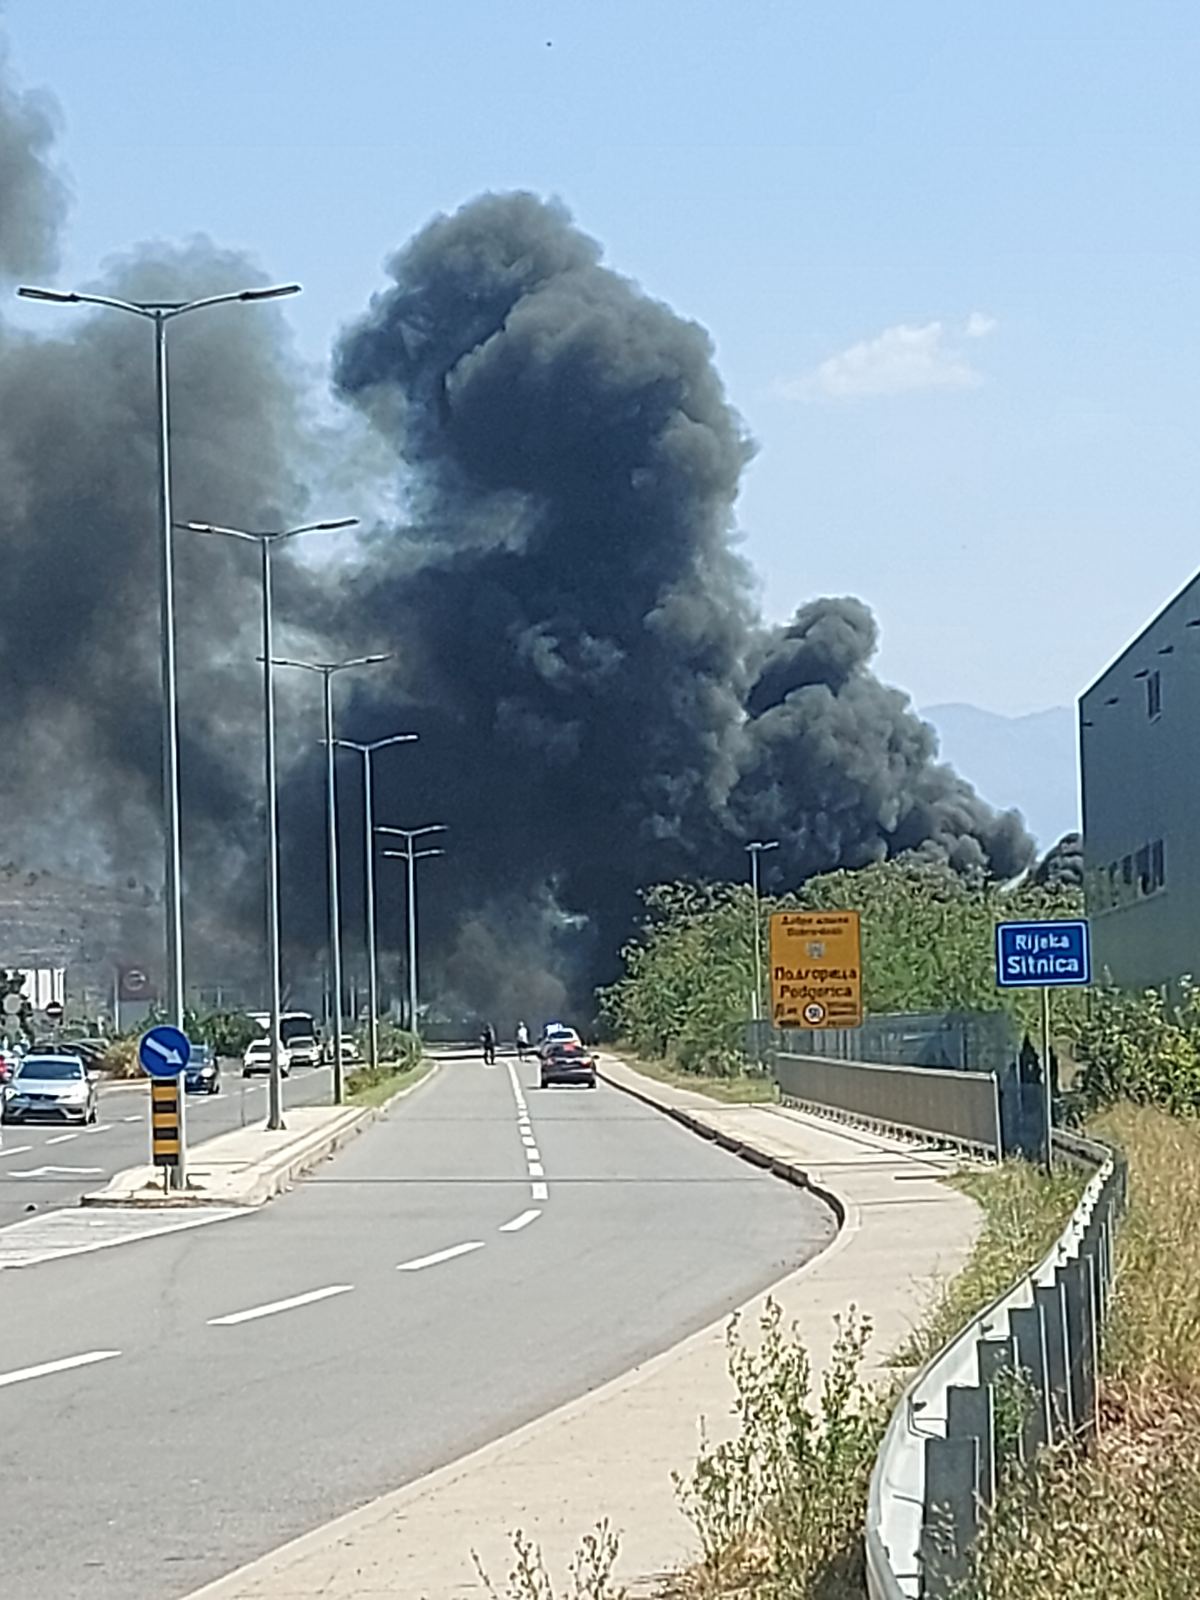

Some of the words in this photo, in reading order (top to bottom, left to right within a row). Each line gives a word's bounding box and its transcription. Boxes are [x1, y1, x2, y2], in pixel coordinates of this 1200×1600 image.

[1015, 933, 1070, 954] Rijeka
[1007, 954, 1079, 975] Sitnica
[780, 984, 852, 1000] Podgorica
